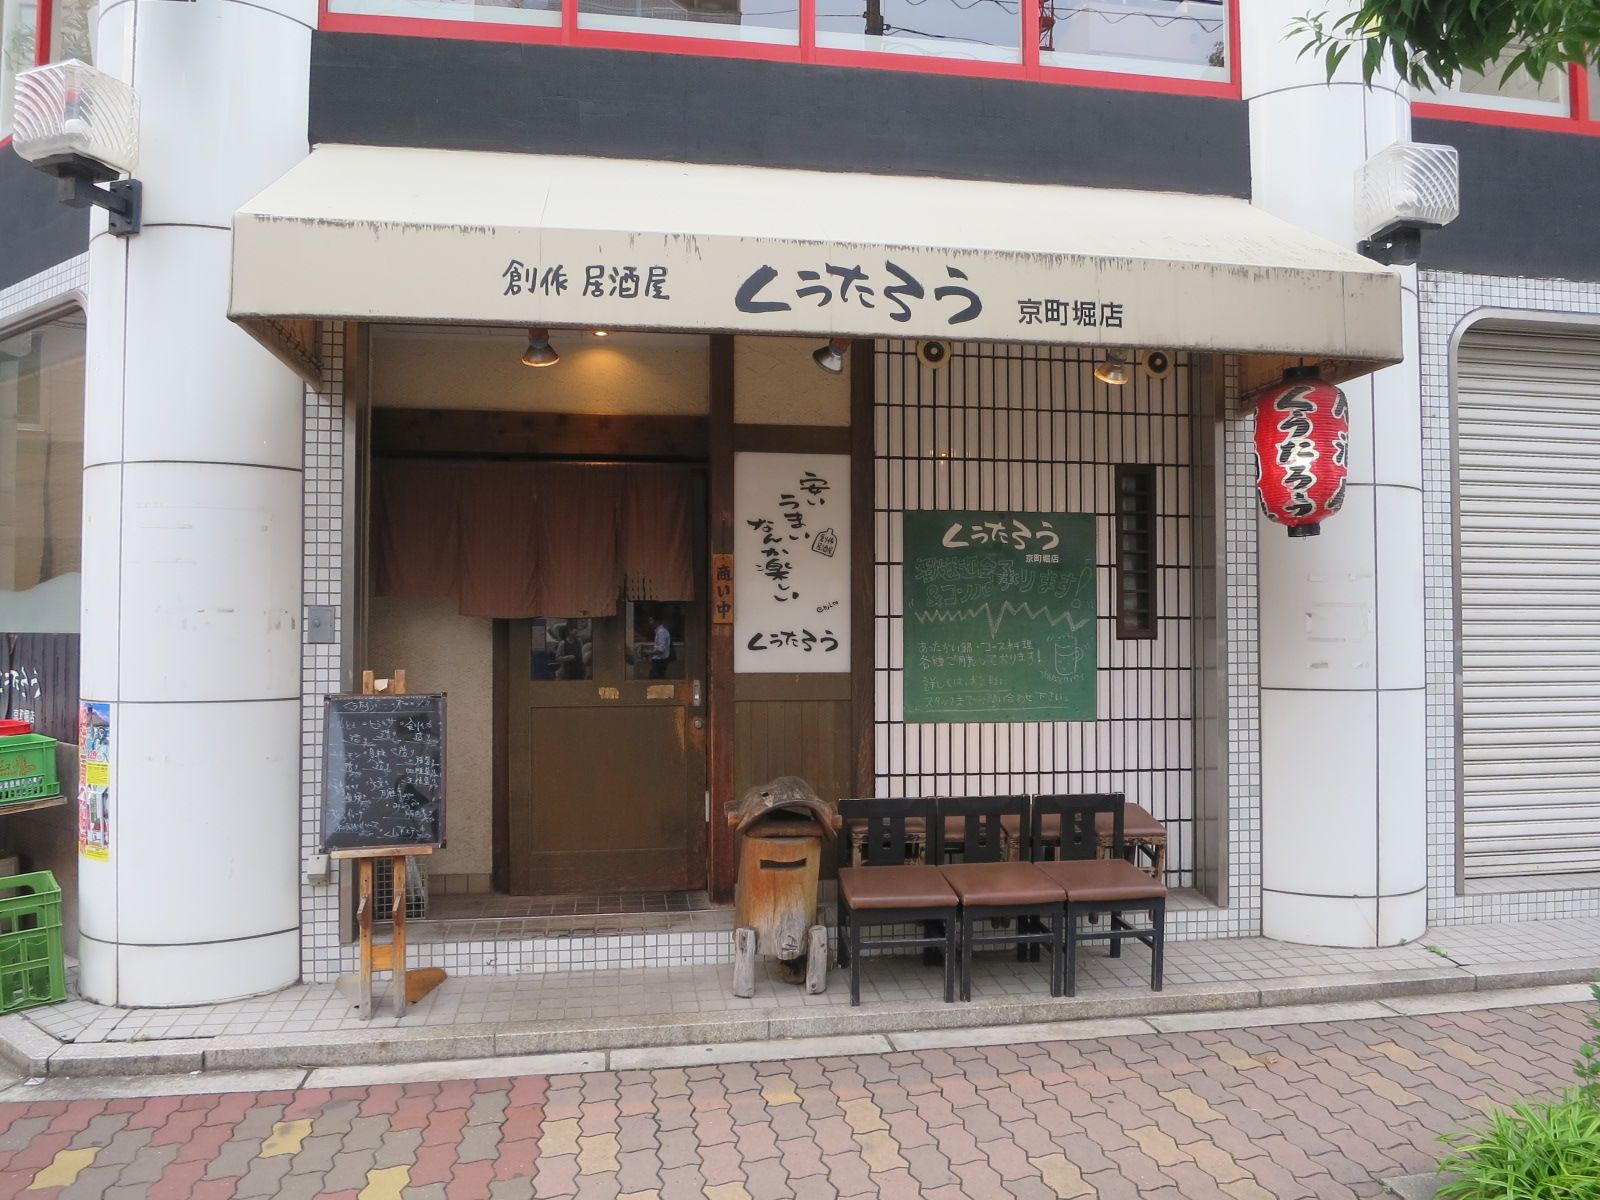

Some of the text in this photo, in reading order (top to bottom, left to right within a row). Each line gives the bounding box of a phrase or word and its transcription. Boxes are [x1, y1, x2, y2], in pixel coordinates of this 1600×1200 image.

[502, 259, 1124, 329] 創作 居酒屋 くうたろう 京町堀店
[1275, 385, 1319, 517] くうたろう
[800, 472, 830, 505] 安い
[779, 494, 810, 541] うまい
[942, 520, 1060, 550] くうたろう
[1025, 554, 1060, 564] 京町堀店
[716, 566, 733, 619] 商い中
[748, 629, 839, 652] くうたろう
